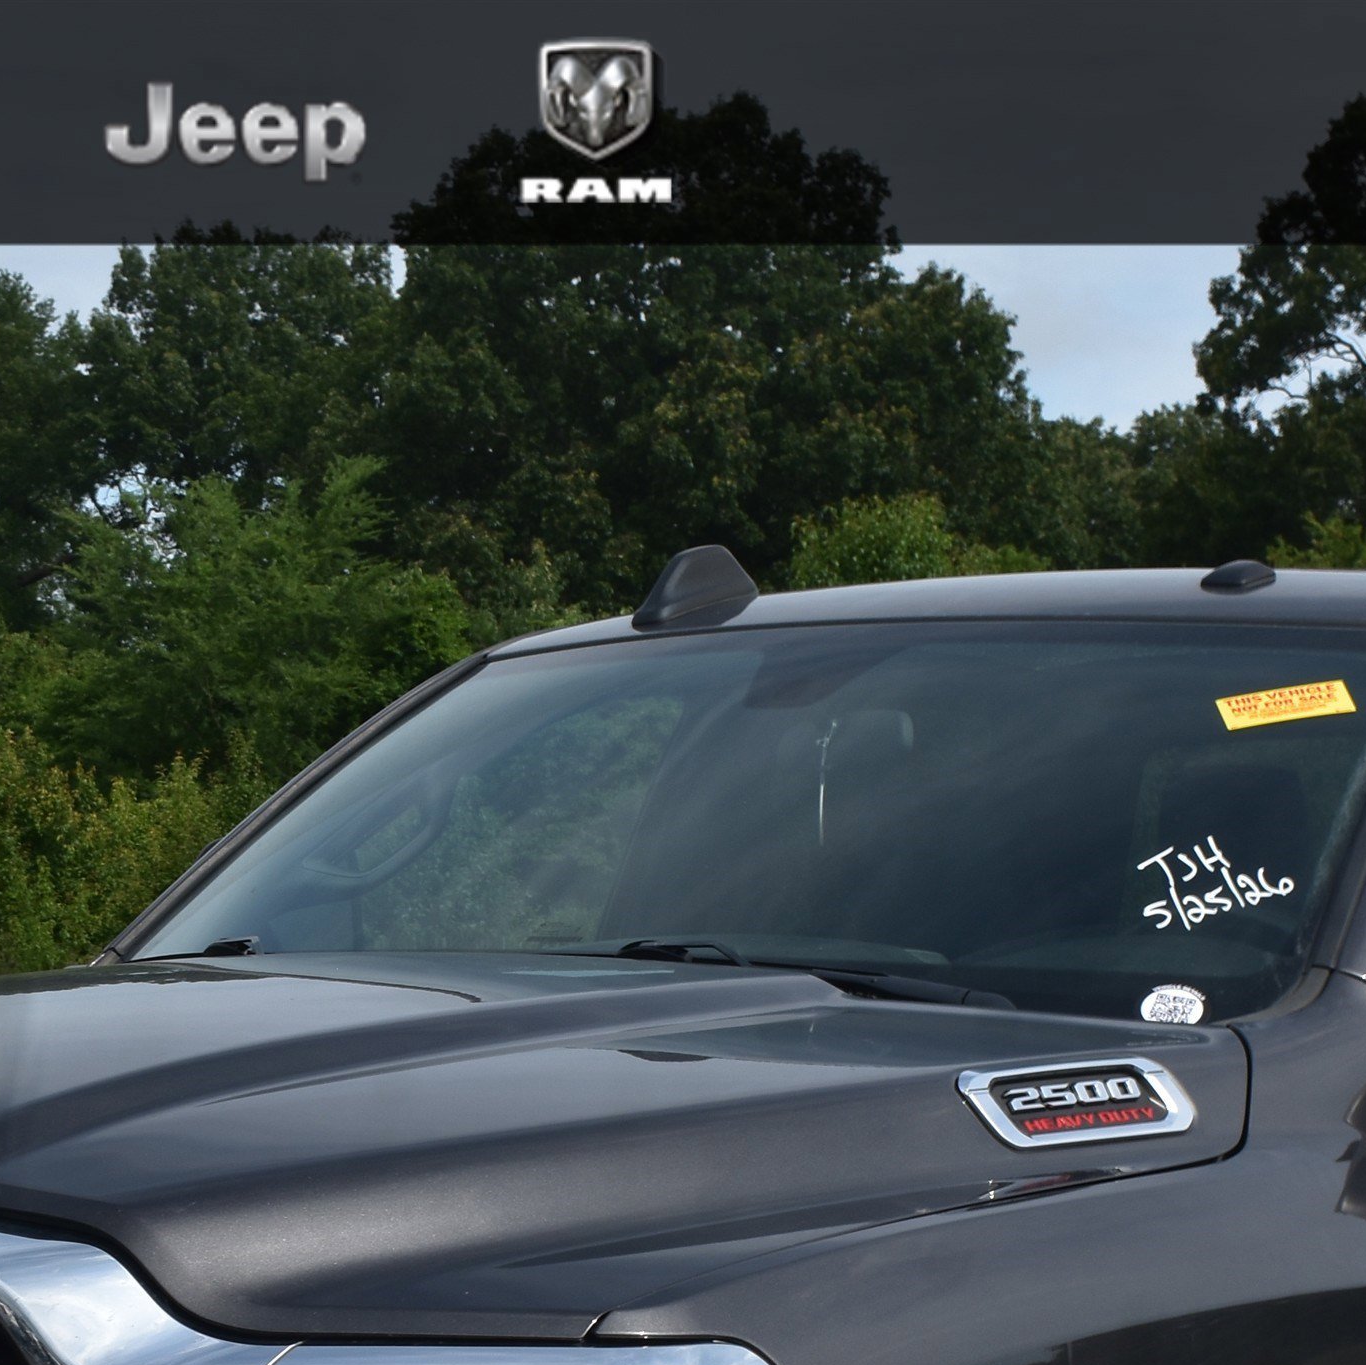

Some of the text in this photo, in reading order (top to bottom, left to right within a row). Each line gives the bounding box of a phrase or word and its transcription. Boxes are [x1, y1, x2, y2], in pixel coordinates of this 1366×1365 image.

[1226, 682, 1335, 708] THIS VEHICLE
[1232, 704, 1258, 714] NOT
[1264, 698, 1294, 709] FOR
[1299, 692, 1337, 703] SALE
[1137, 835, 1231, 888] TJH
[1143, 867, 1295, 931] 5/25/26
[1005, 1076, 1142, 1113] 2500
[1023, 1106, 1156, 1133] HEAVY DUTY
